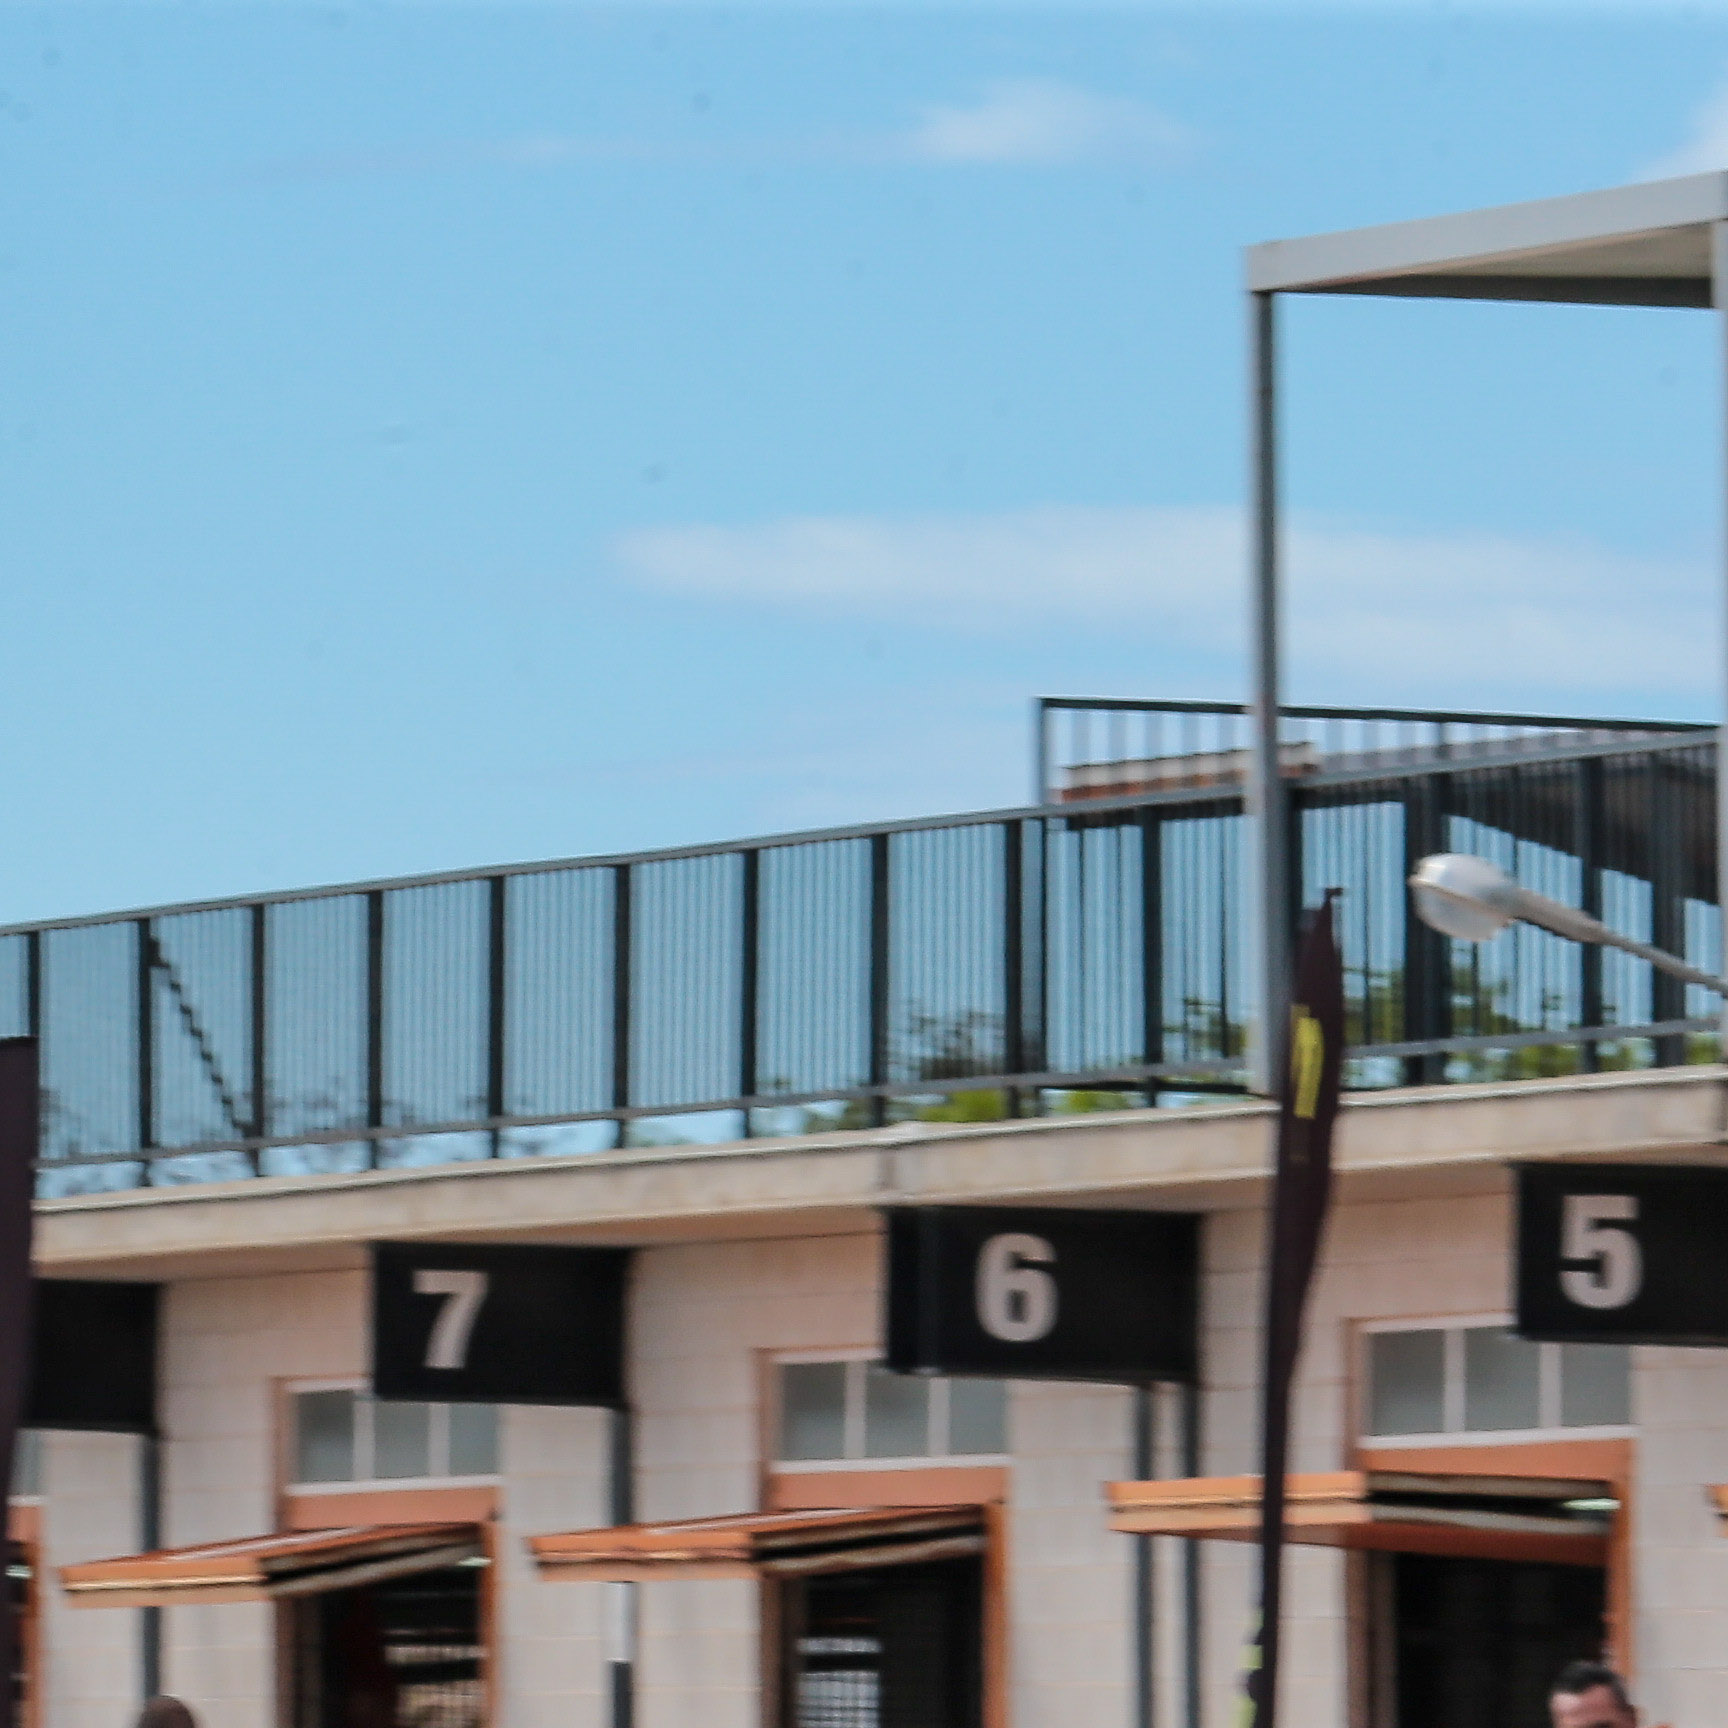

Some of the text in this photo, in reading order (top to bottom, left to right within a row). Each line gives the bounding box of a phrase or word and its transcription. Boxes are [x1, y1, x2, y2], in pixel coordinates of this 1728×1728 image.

[976, 1233, 1058, 1342] 6
[1559, 1195, 1643, 1310] 5
[412, 1269, 489, 1370] 7
